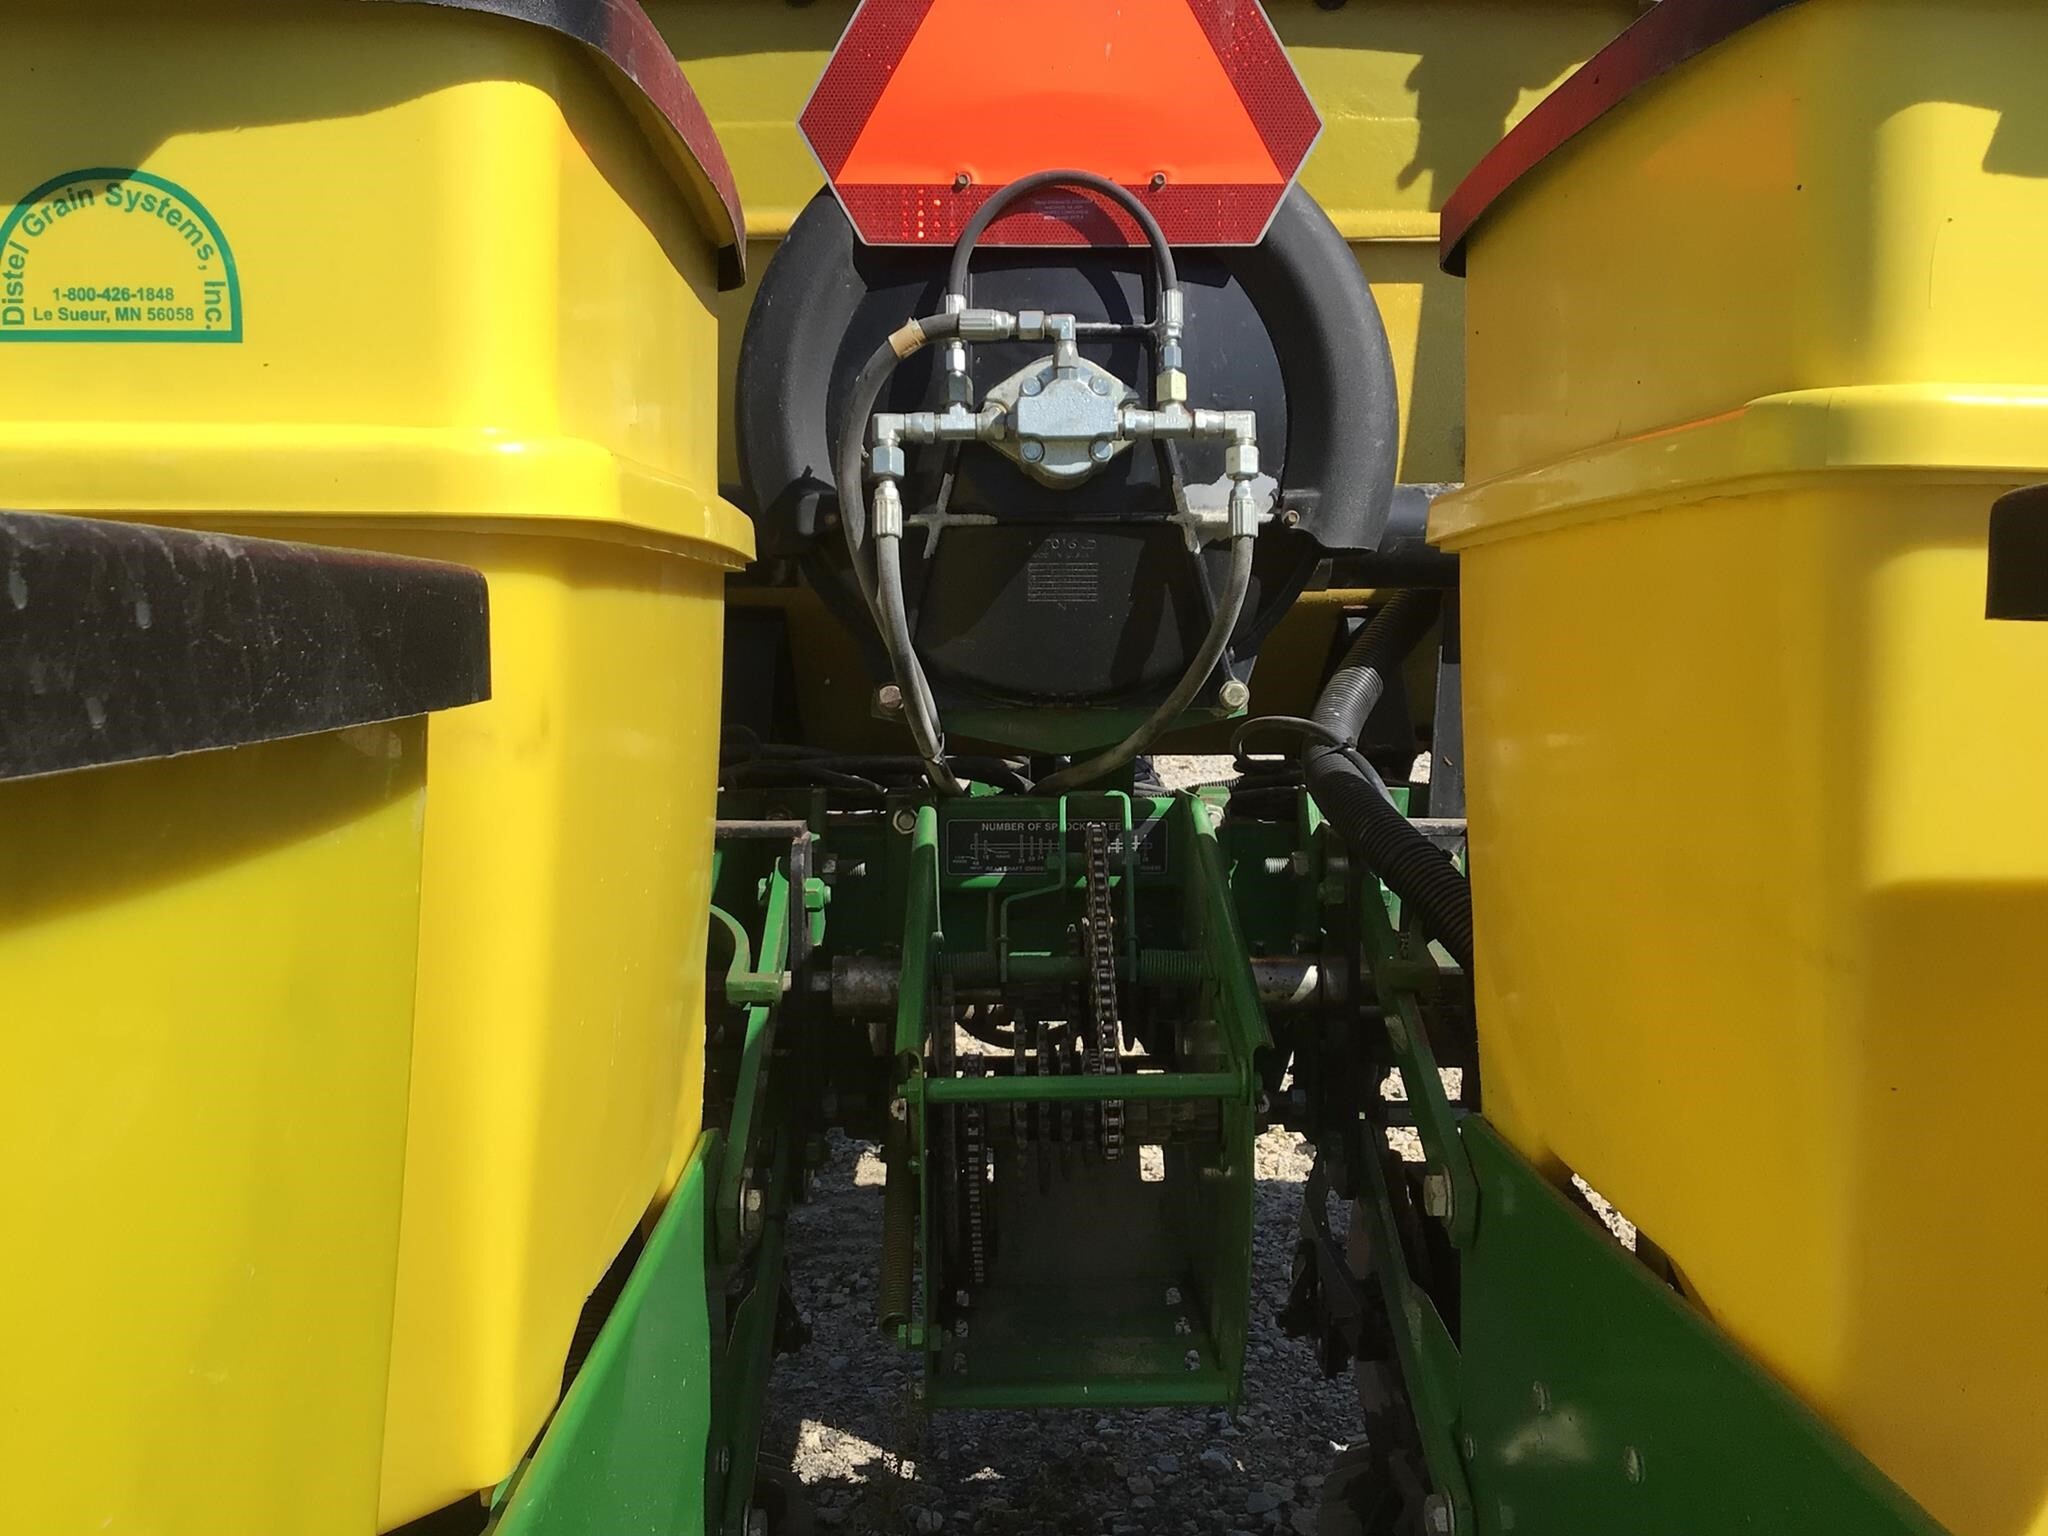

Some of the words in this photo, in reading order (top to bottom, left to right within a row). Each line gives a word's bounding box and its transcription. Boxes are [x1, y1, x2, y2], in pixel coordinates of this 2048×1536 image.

[2, 240, 29, 326] Distel
[21, 186, 95, 237] Grain
[105, 182, 214, 271] Systems,
[204, 281, 226, 330] Inc.
[53, 287, 174, 302] 1-800-426-1848
[33, 307, 53, 321] Le
[58, 307, 110, 323] Sueur,
[115, 307, 141, 321] MN
[147, 307, 194, 321] 56058
[981, 822, 1025, 832] NUMBER
[1027, 822, 1042, 832] OF
